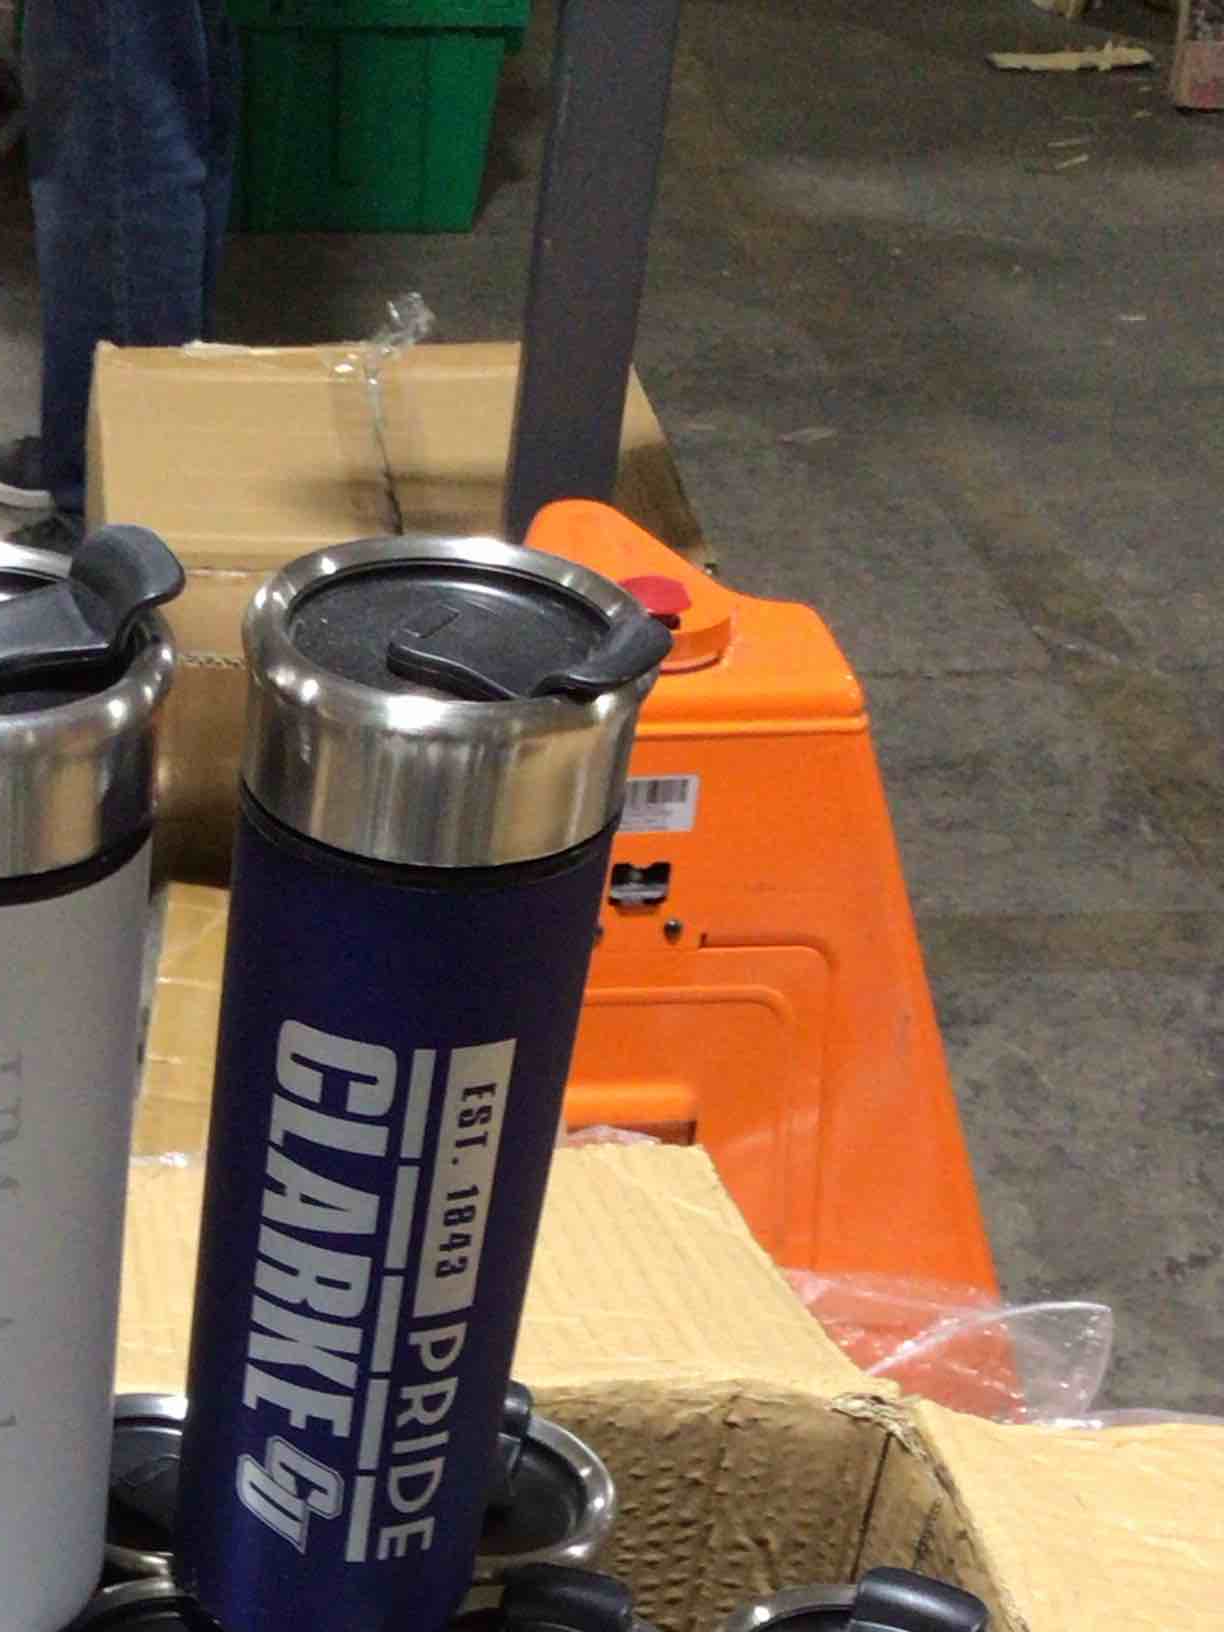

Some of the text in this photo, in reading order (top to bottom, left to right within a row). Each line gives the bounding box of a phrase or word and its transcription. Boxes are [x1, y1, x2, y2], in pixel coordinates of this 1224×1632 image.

[242, 1019, 398, 1437] CLARKE
[434, 1082, 496, 1282] EST. 1843
[376, 1323, 466, 1561] PRIDE
